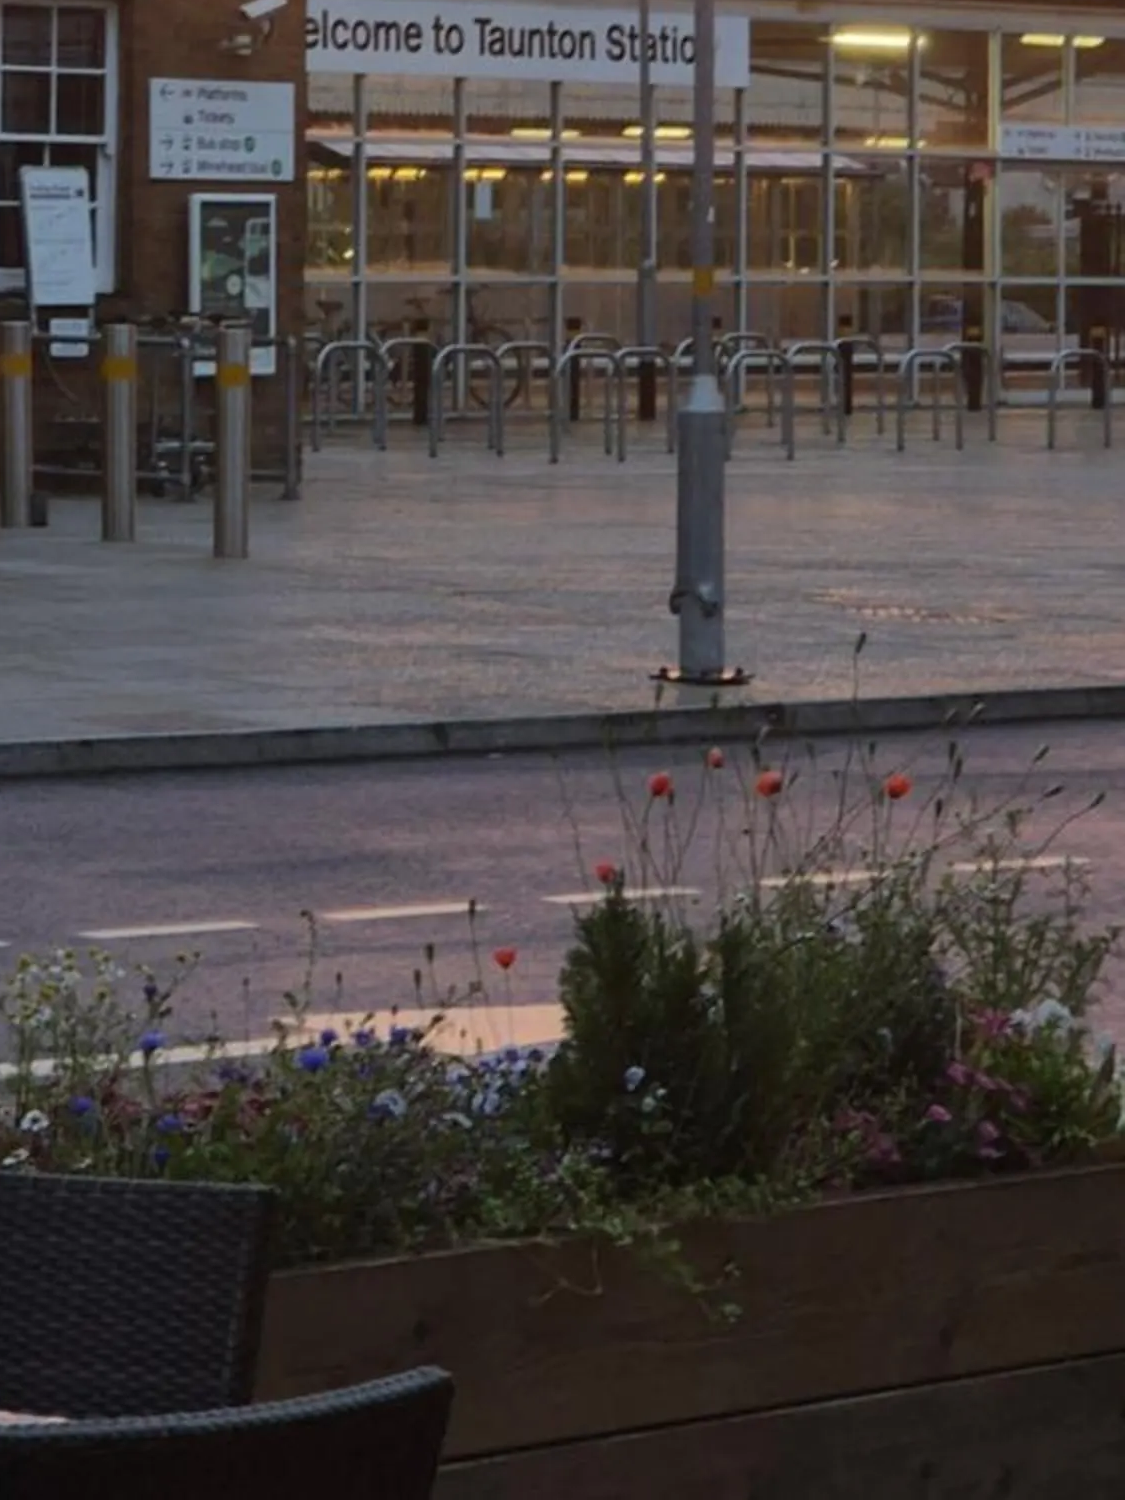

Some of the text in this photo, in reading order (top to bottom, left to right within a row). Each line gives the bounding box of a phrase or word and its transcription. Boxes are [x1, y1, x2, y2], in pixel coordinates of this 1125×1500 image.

[305, 10, 696, 65] elcome to Taunton Statio
